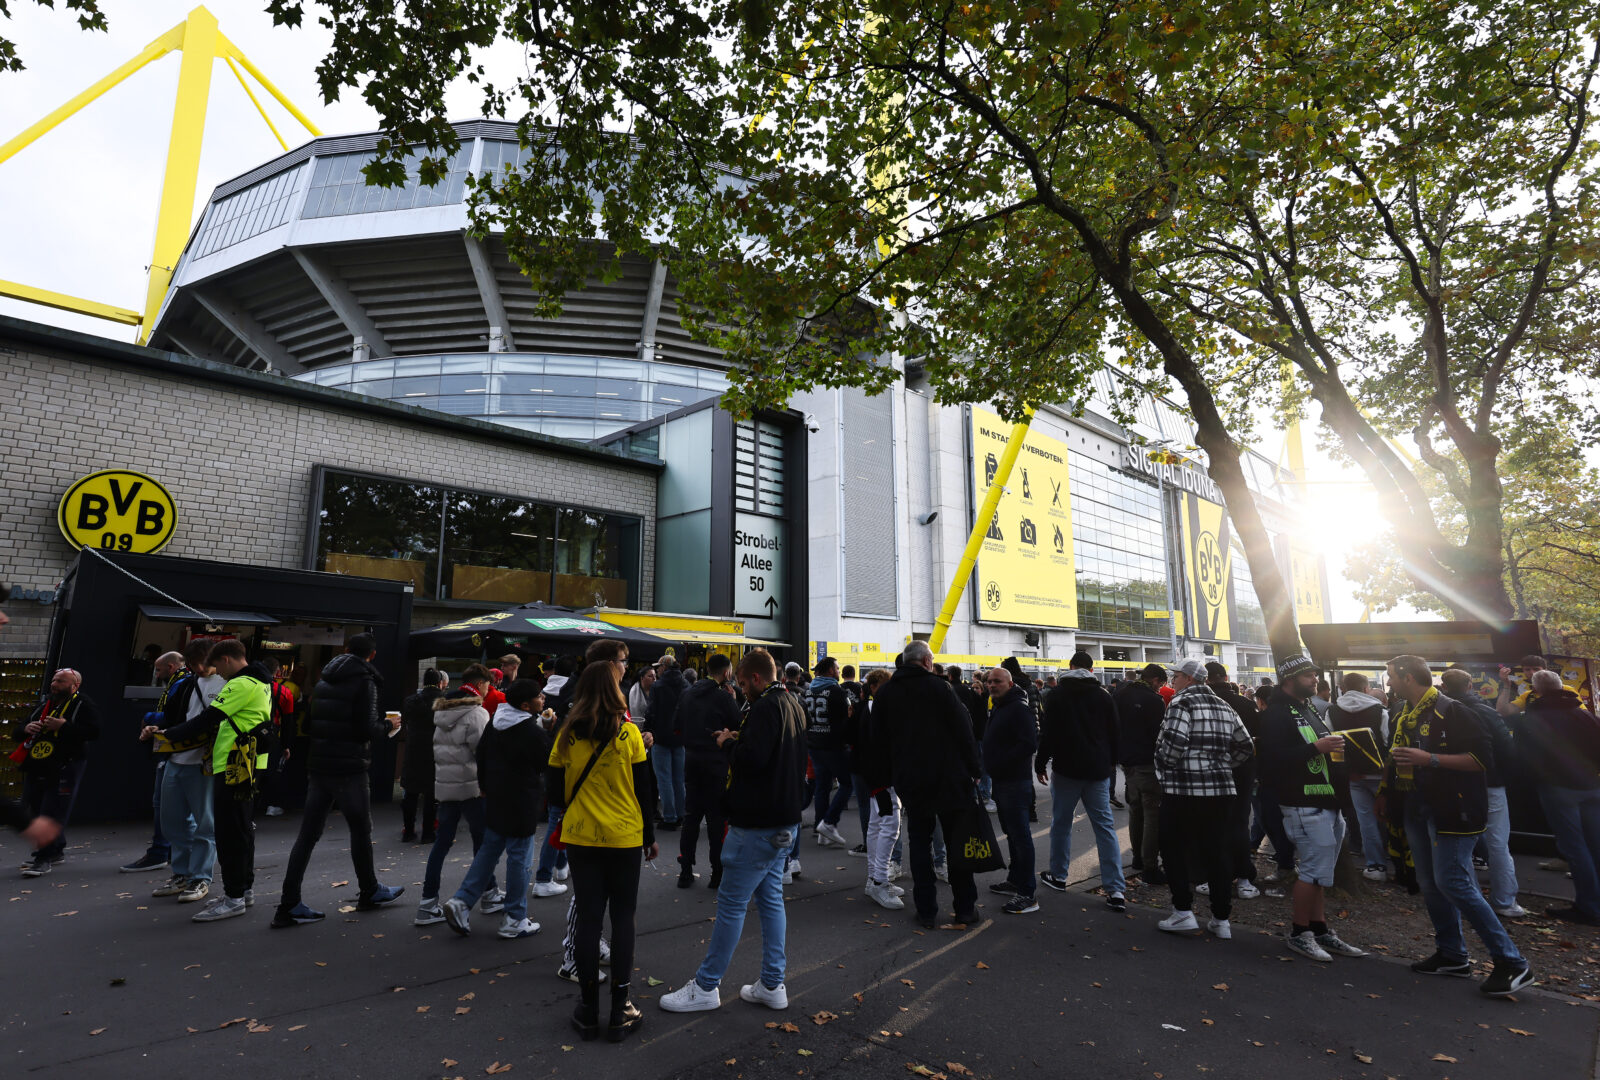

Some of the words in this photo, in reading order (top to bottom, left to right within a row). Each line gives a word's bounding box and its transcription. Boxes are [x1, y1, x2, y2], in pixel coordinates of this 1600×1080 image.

[980, 427, 990, 437] IM
[992, 431, 1025, 450] STAN
[1026, 443, 1064, 465] VERBOTEN:
[1181, 465, 1216, 502] IDUNA
[77, 479, 165, 536] BVB
[101, 532, 133, 551] 09
[735, 530, 781, 551] Strobel-
[741, 553, 772, 571] Allee
[1200, 537, 1222, 585] BVB
[749, 576, 764, 592] 50
[987, 584, 1000, 602] BVB
[1208, 583, 1218, 600] 09
[33, 742, 51, 754] BVB
